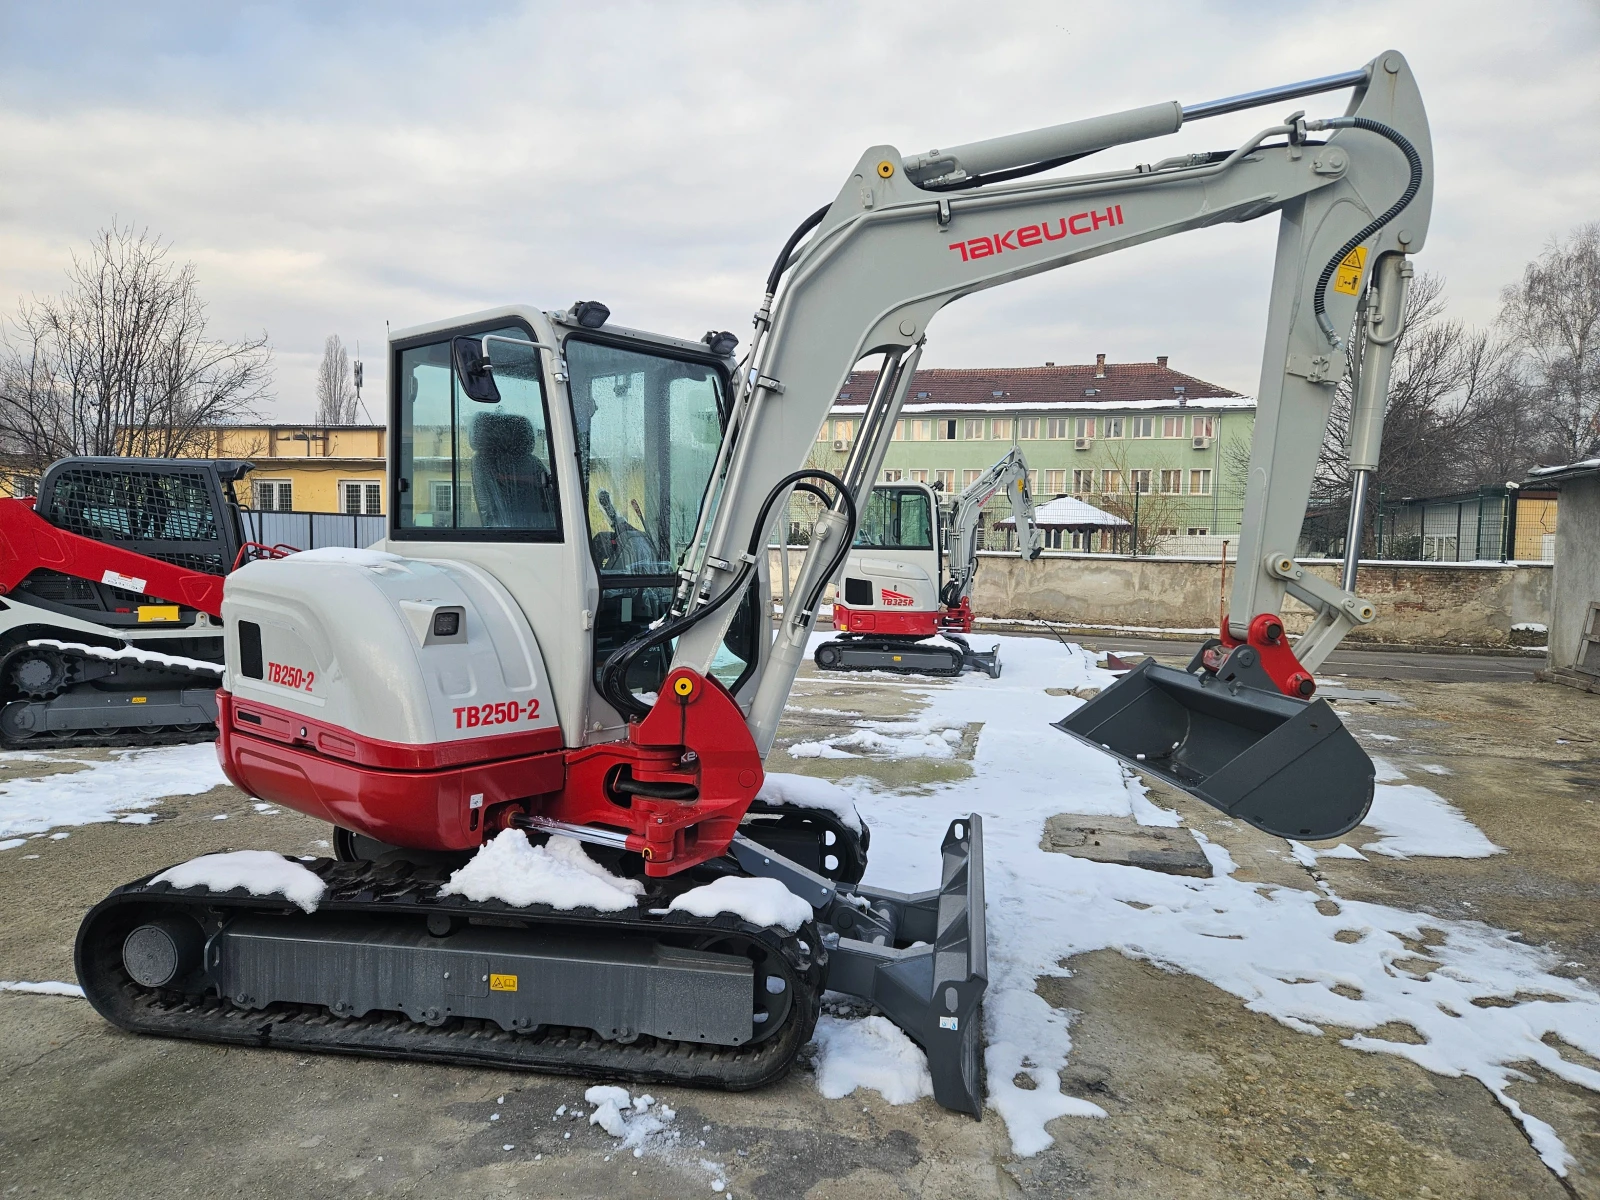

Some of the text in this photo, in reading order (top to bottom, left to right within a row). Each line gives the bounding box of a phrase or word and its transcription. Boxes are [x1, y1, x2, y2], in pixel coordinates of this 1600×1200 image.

[882, 598, 914, 607] TB325R
[268, 661, 314, 693] TB250-2
[453, 698, 540, 729] TB250-2
